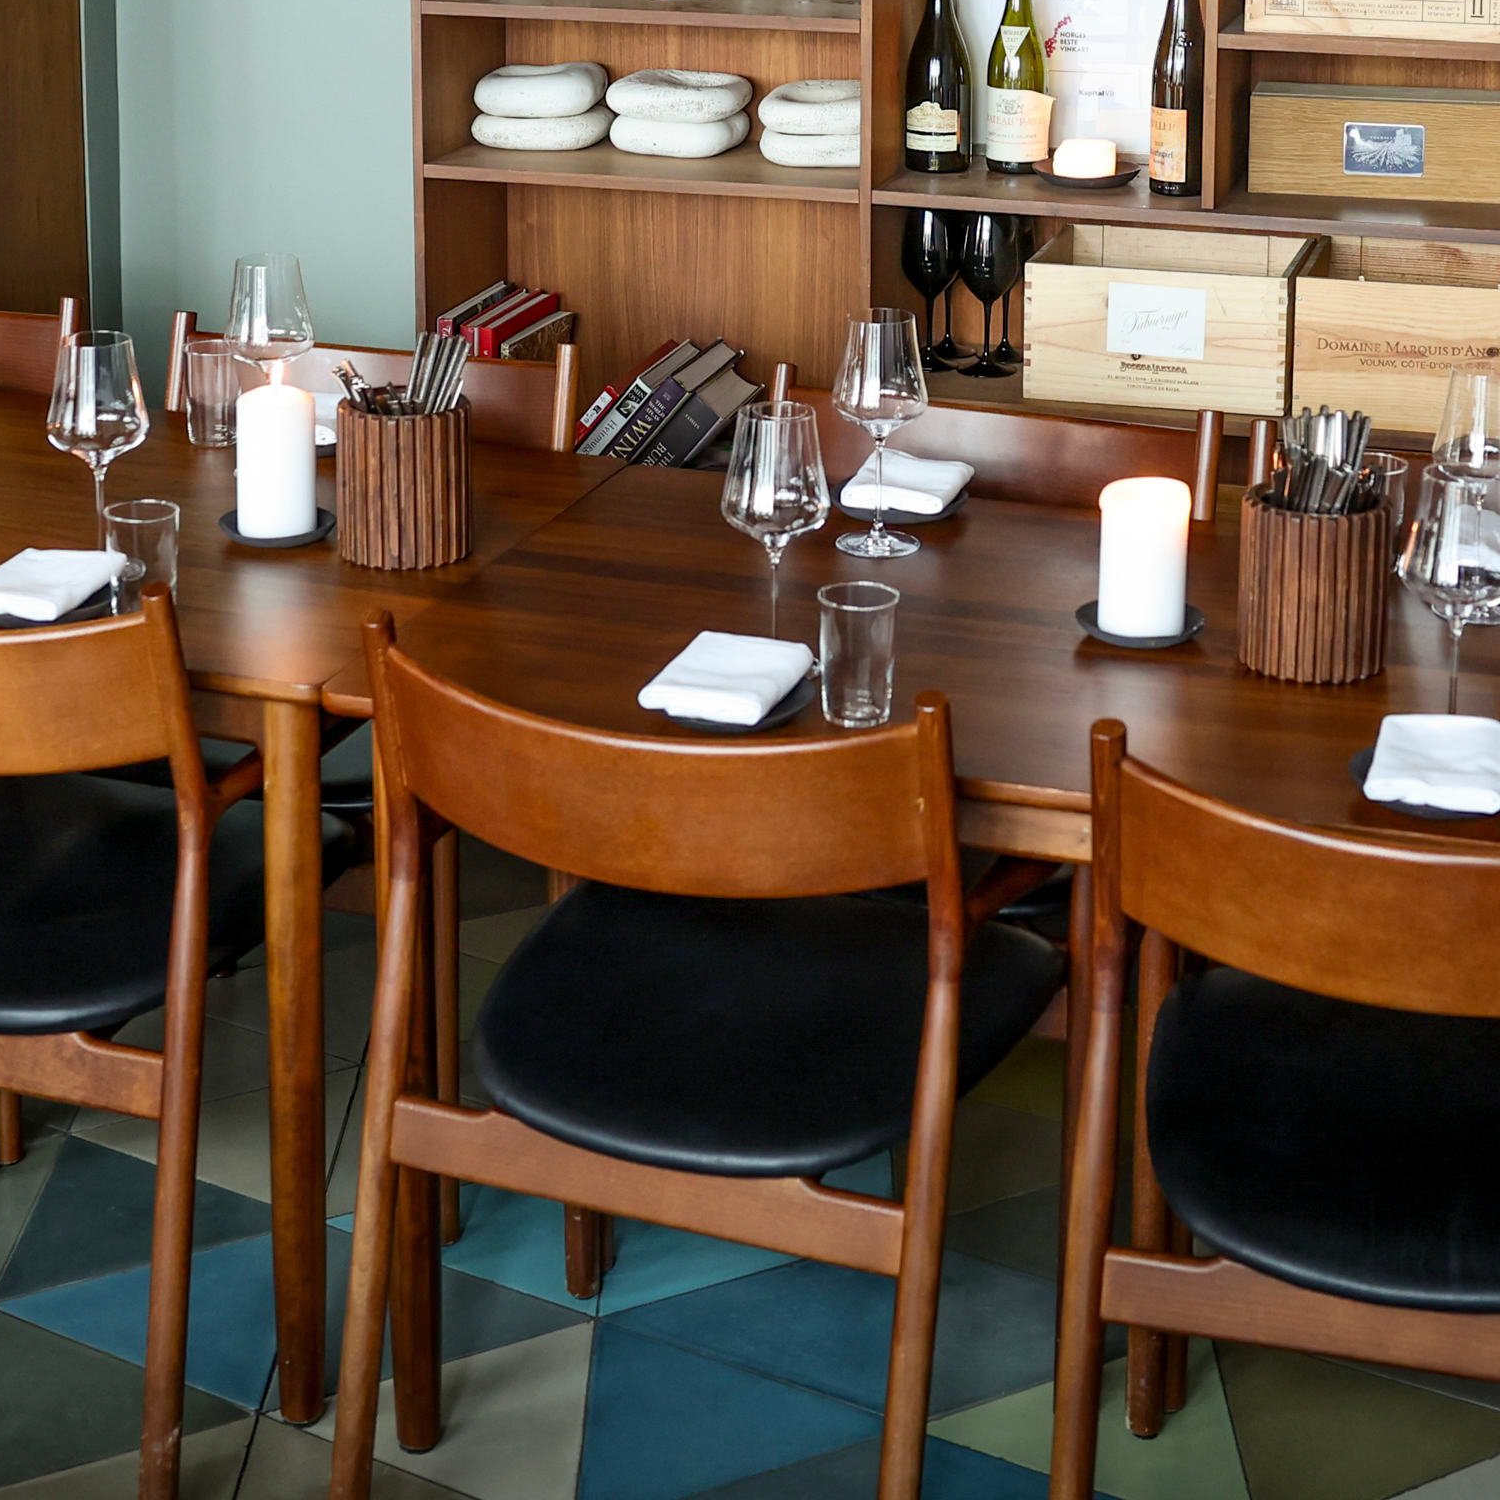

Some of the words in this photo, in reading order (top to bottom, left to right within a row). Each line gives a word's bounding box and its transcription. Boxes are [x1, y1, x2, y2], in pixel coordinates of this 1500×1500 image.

[1317, 337, 1381, 353] DOMAINE
[1385, 340, 1449, 357] MARQUIS
[1359, 358, 1398, 368] VOLNAY,
[632, 386, 646, 399] MIN
[623, 402, 633, 414] 2
[649, 402, 666, 418] WORLD
[655, 399, 667, 410] THE
